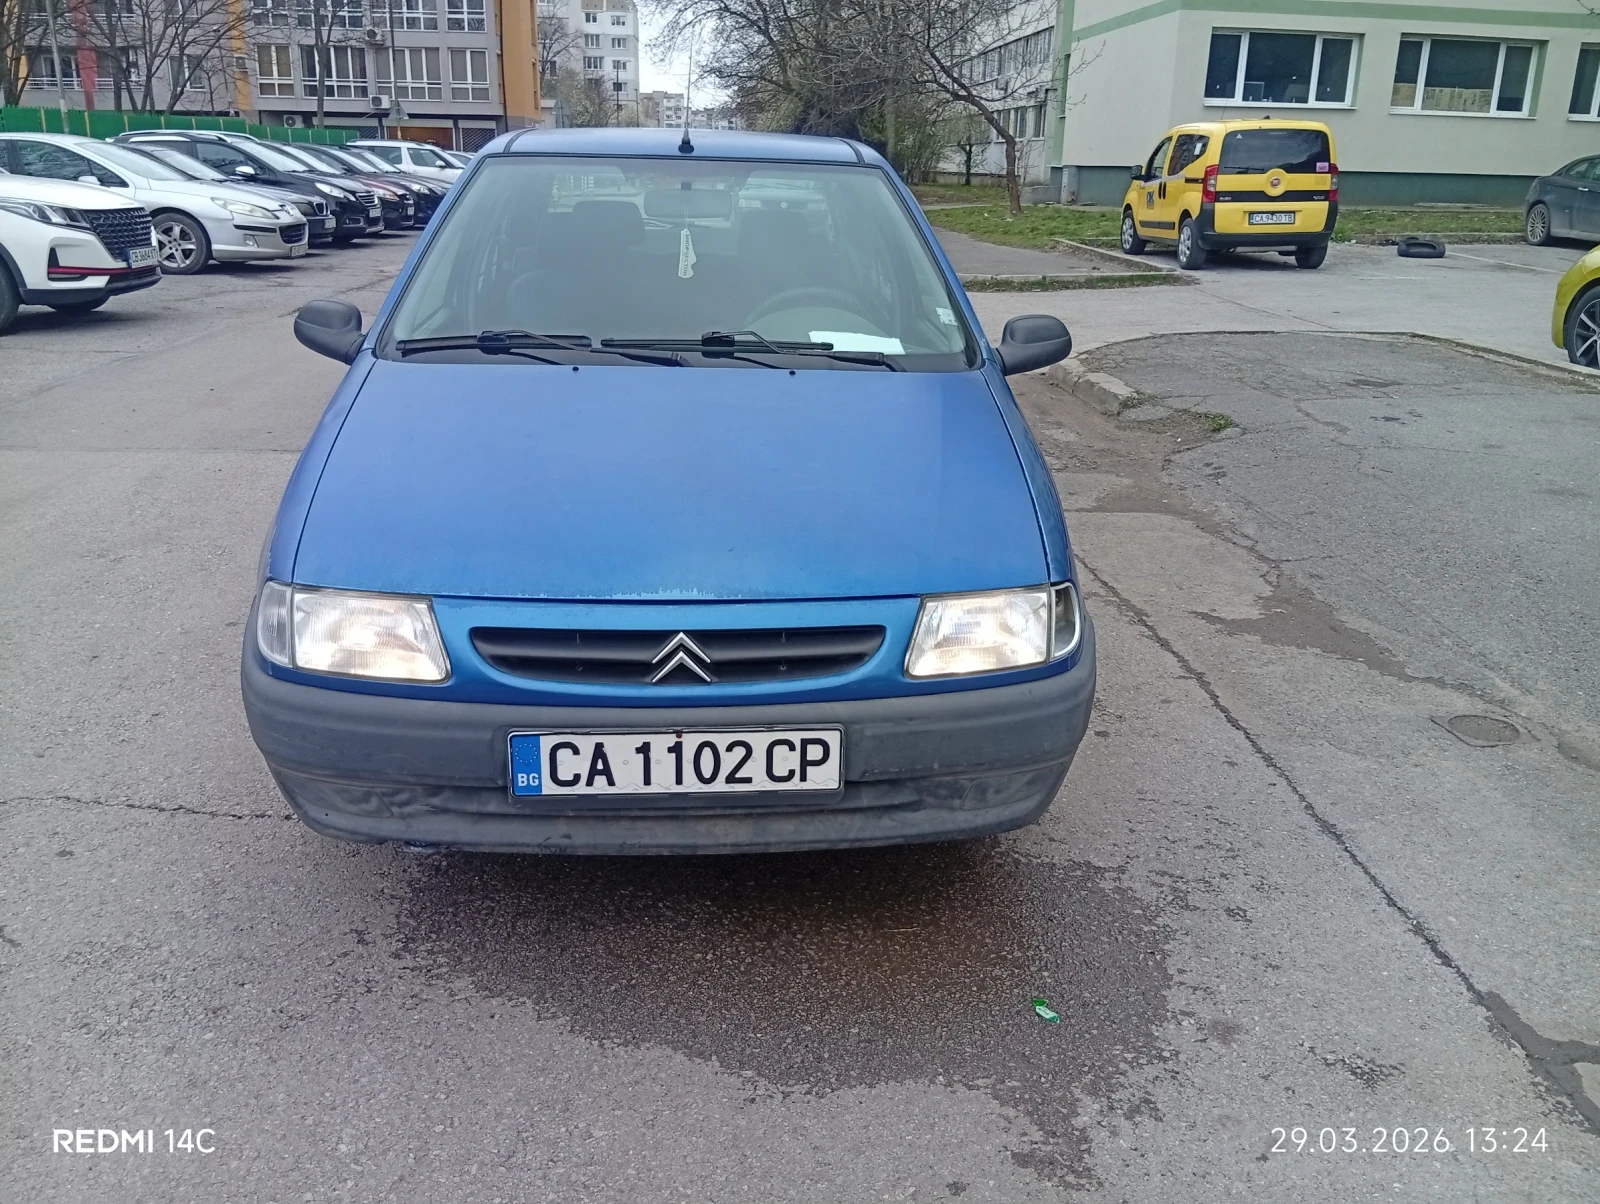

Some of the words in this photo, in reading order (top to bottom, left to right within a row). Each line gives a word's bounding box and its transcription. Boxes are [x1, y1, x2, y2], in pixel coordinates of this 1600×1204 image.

[1254, 214, 1264, 223] CA
[1284, 214, 1293, 222] TB
[132, 251, 139, 263] CB
[549, 741, 616, 787] CA
[635, 740, 753, 786] 1102
[765, 738, 831, 783] CP
[517, 773, 539, 787] BG
